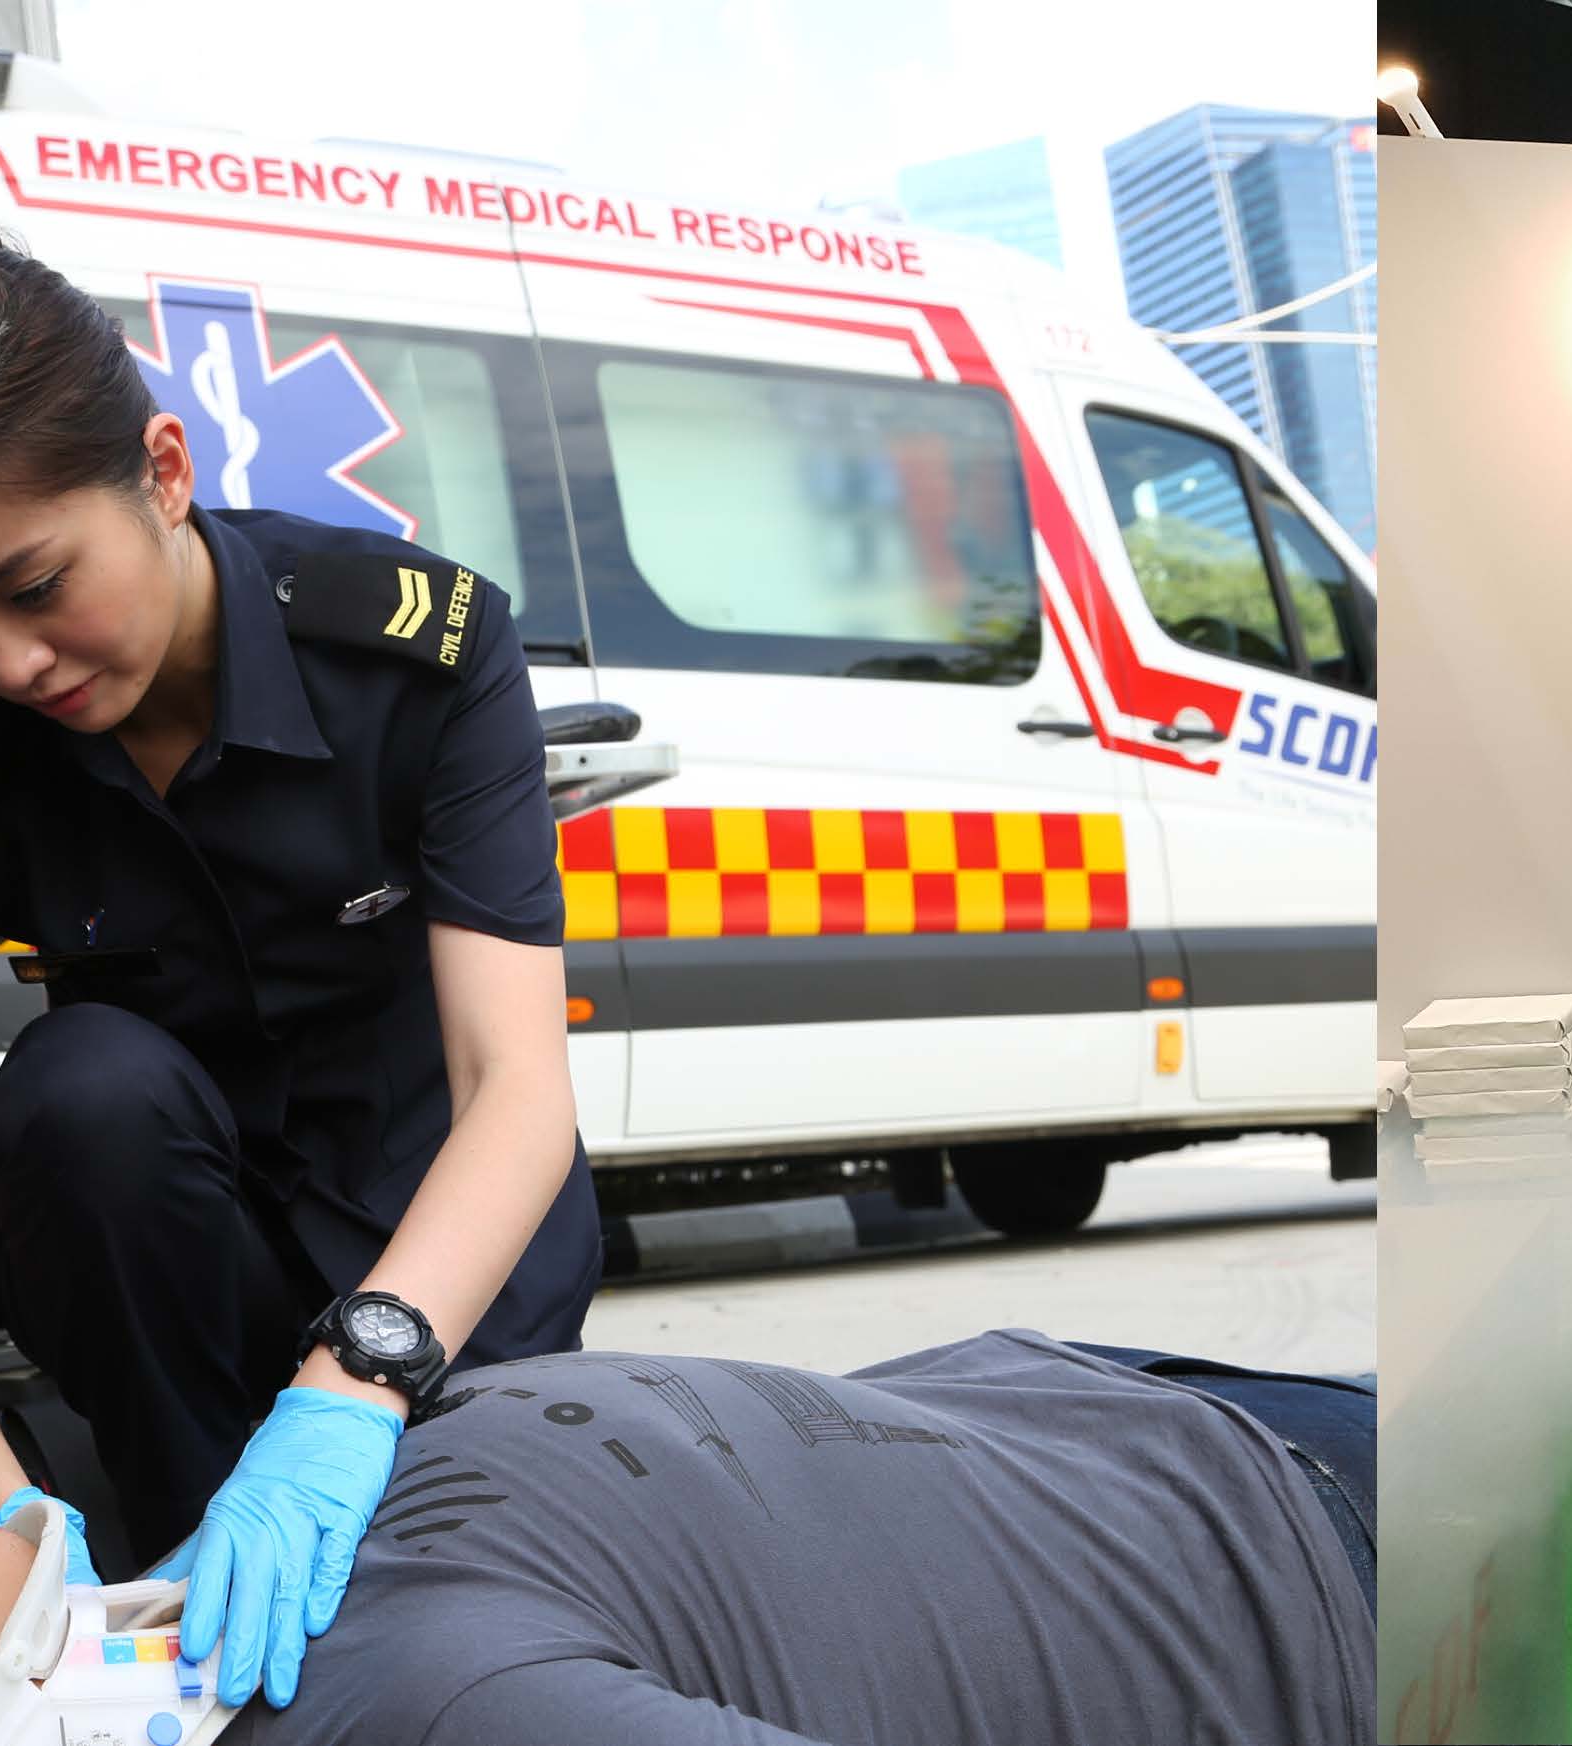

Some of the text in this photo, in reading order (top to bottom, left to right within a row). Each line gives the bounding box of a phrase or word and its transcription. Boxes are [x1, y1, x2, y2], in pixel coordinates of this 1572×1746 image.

[36, 136, 926, 277] EMERGENCY MEDICAL RESPONSE
[439, 567, 475, 666] CIVIL DEFENCE
